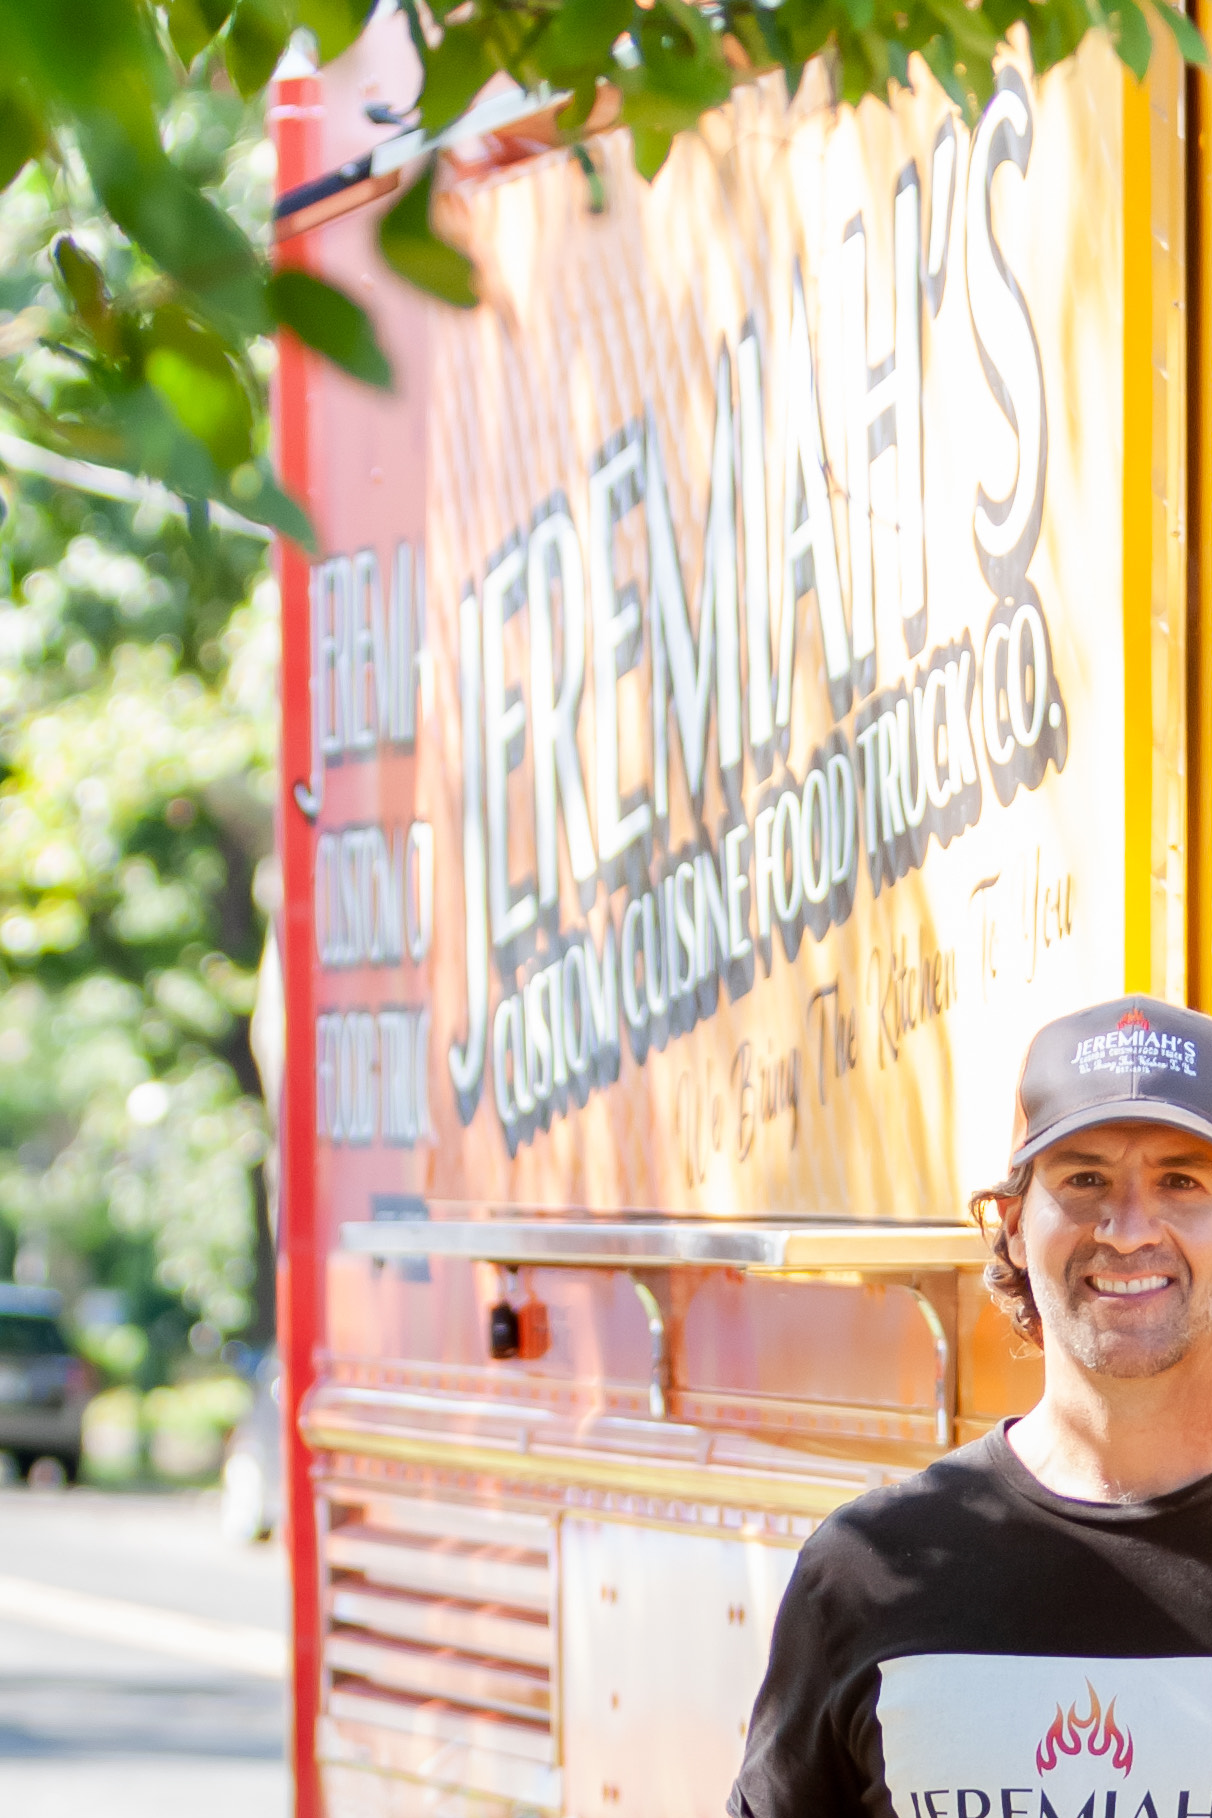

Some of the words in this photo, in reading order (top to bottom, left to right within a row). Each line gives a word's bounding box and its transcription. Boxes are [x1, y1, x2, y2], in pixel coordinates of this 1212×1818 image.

[450, 75, 1046, 1115] JEREMIAH'S
[493, 930, 619, 1128] CUSTOM
[621, 824, 752, 1028] CUISINE
[754, 753, 855, 942] FOOD
[857, 651, 978, 856] TRUCK
[983, 604, 1062, 766] CO.
[806, 975, 858, 1106] The
[866, 932, 958, 1071] Kitchen
[1070, 1030, 1197, 1065] JEREMIAH'S
